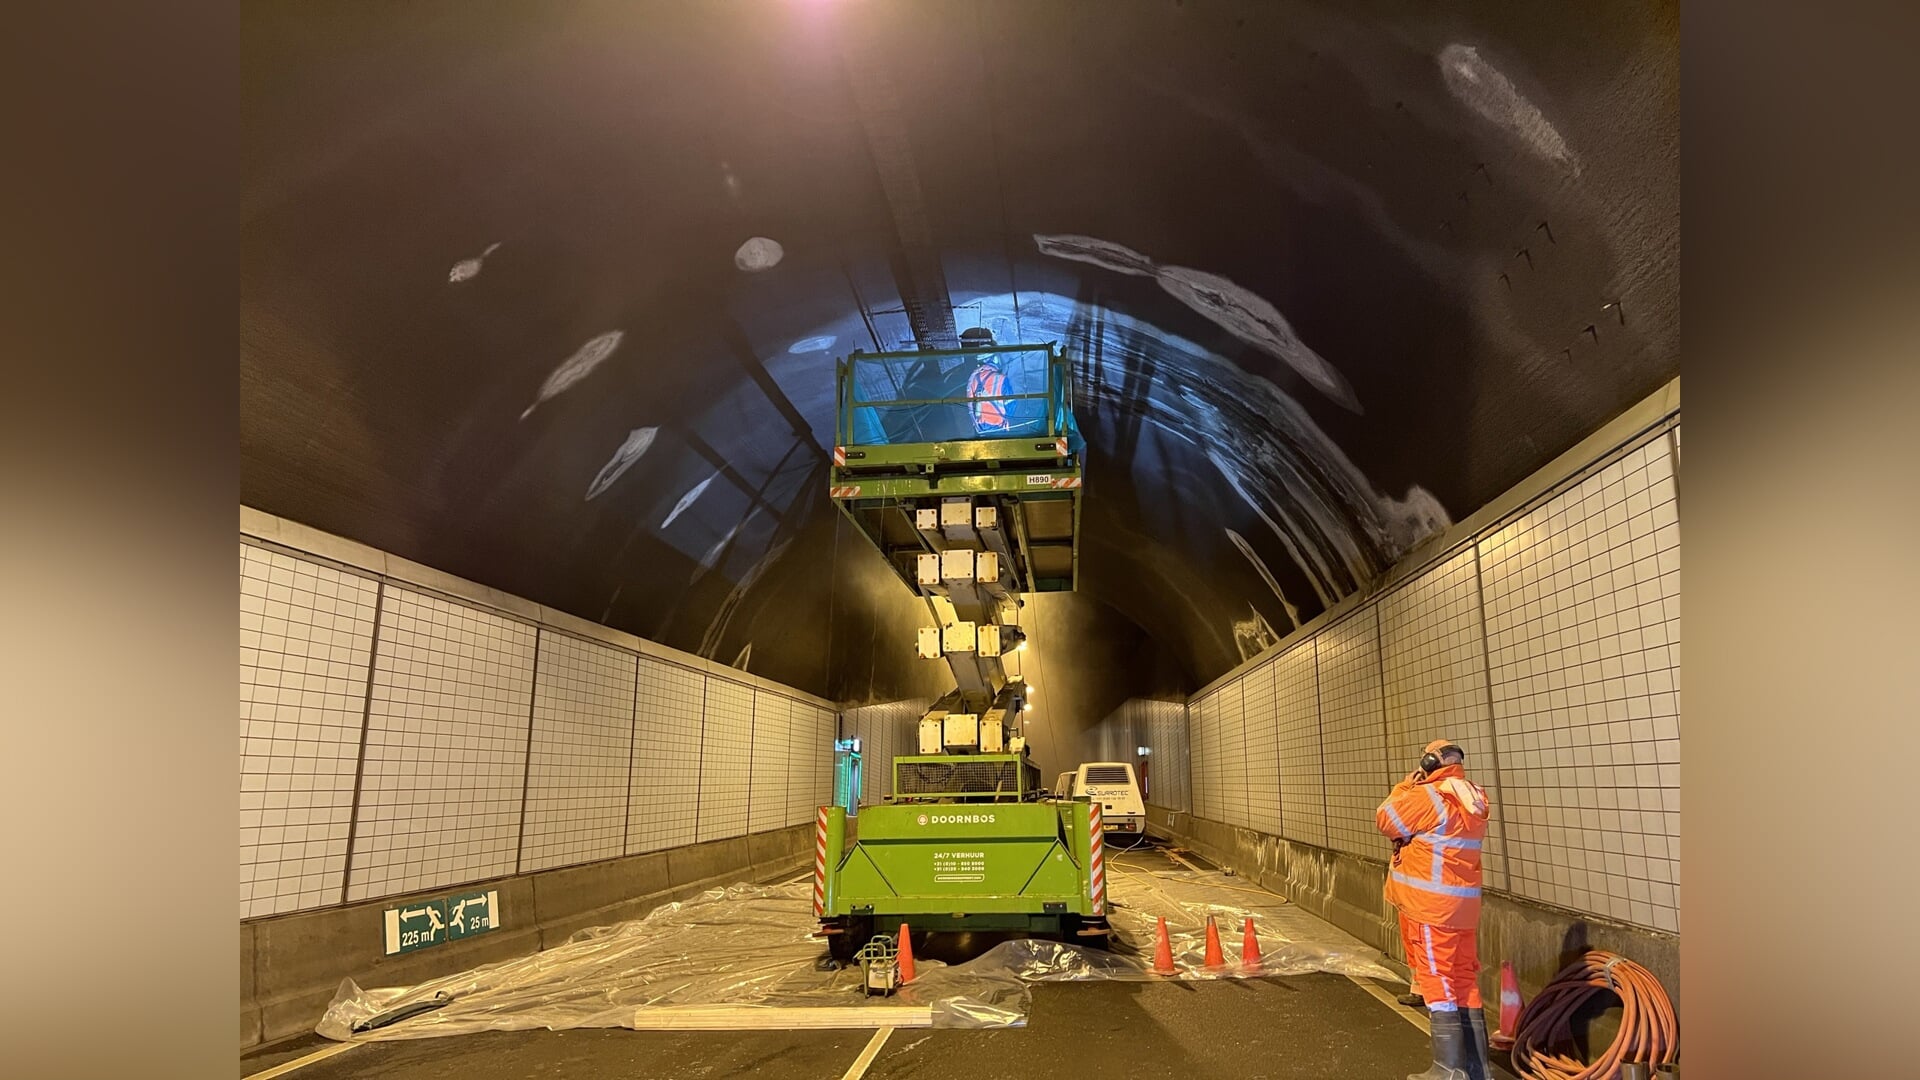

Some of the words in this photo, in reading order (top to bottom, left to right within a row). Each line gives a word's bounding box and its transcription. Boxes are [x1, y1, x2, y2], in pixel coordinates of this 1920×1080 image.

[931, 814, 996, 824] DOORNBOS
[470, 916, 480, 930] 25
[481, 917, 489, 928] m
[402, 930, 419, 947] 225
[421, 931, 430, 942] m
